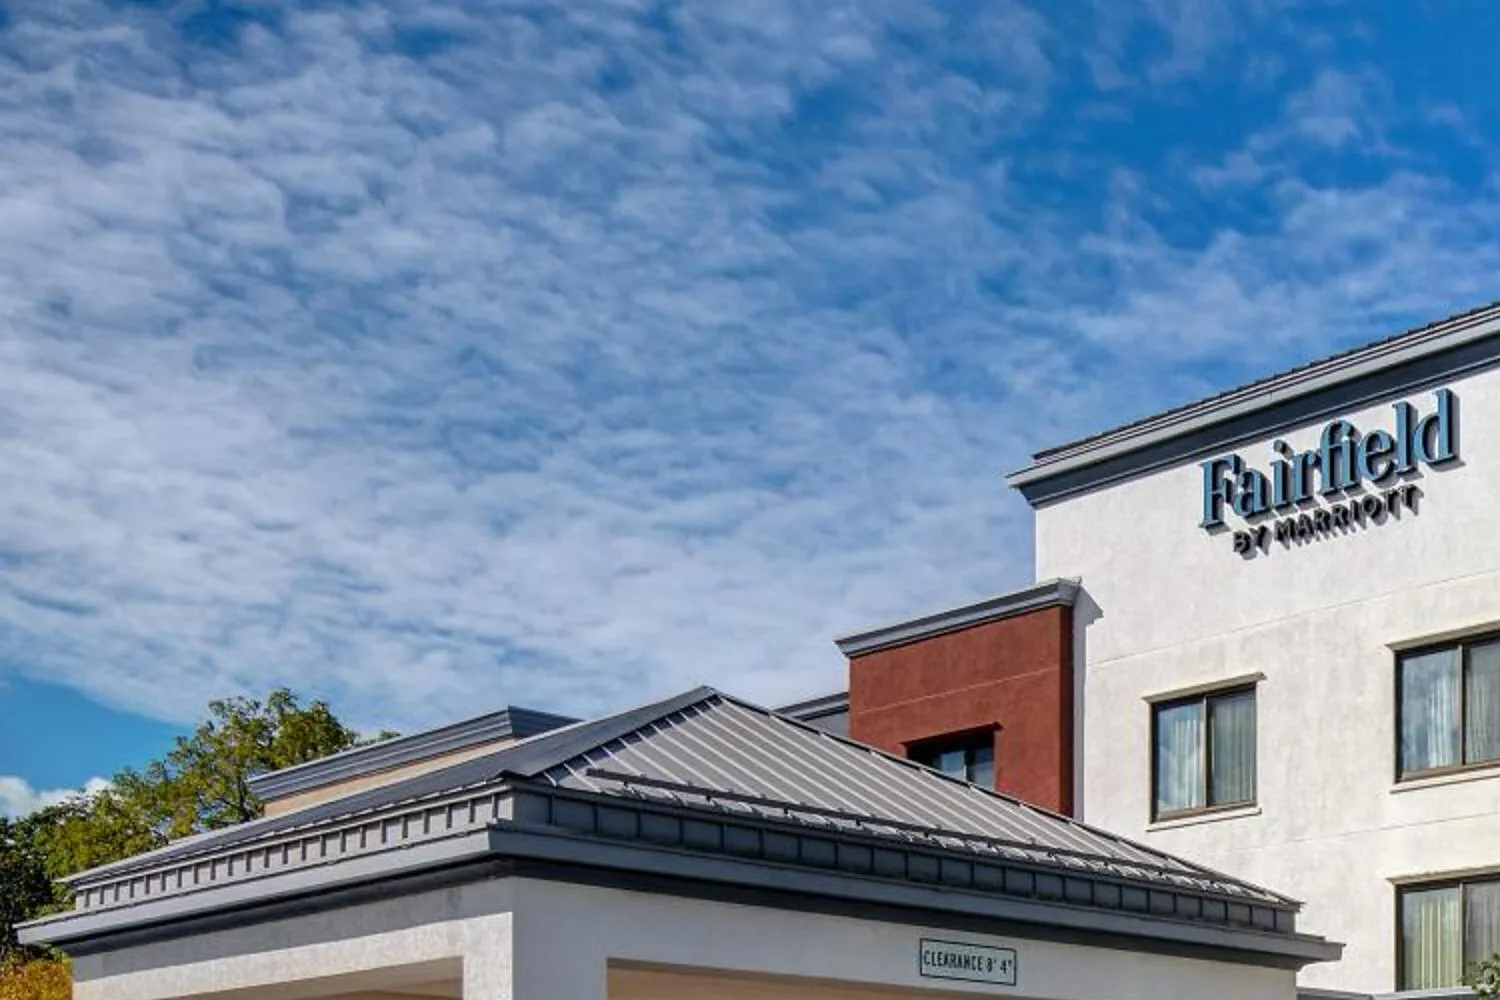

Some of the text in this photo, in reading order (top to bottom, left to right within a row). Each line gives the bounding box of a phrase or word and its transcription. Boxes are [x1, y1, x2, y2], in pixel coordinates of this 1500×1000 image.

[1199, 388, 1459, 531] Fairfield
[1233, 484, 1421, 557] BY MARRIOTT
[923, 949, 983, 973] CLEARANCE
